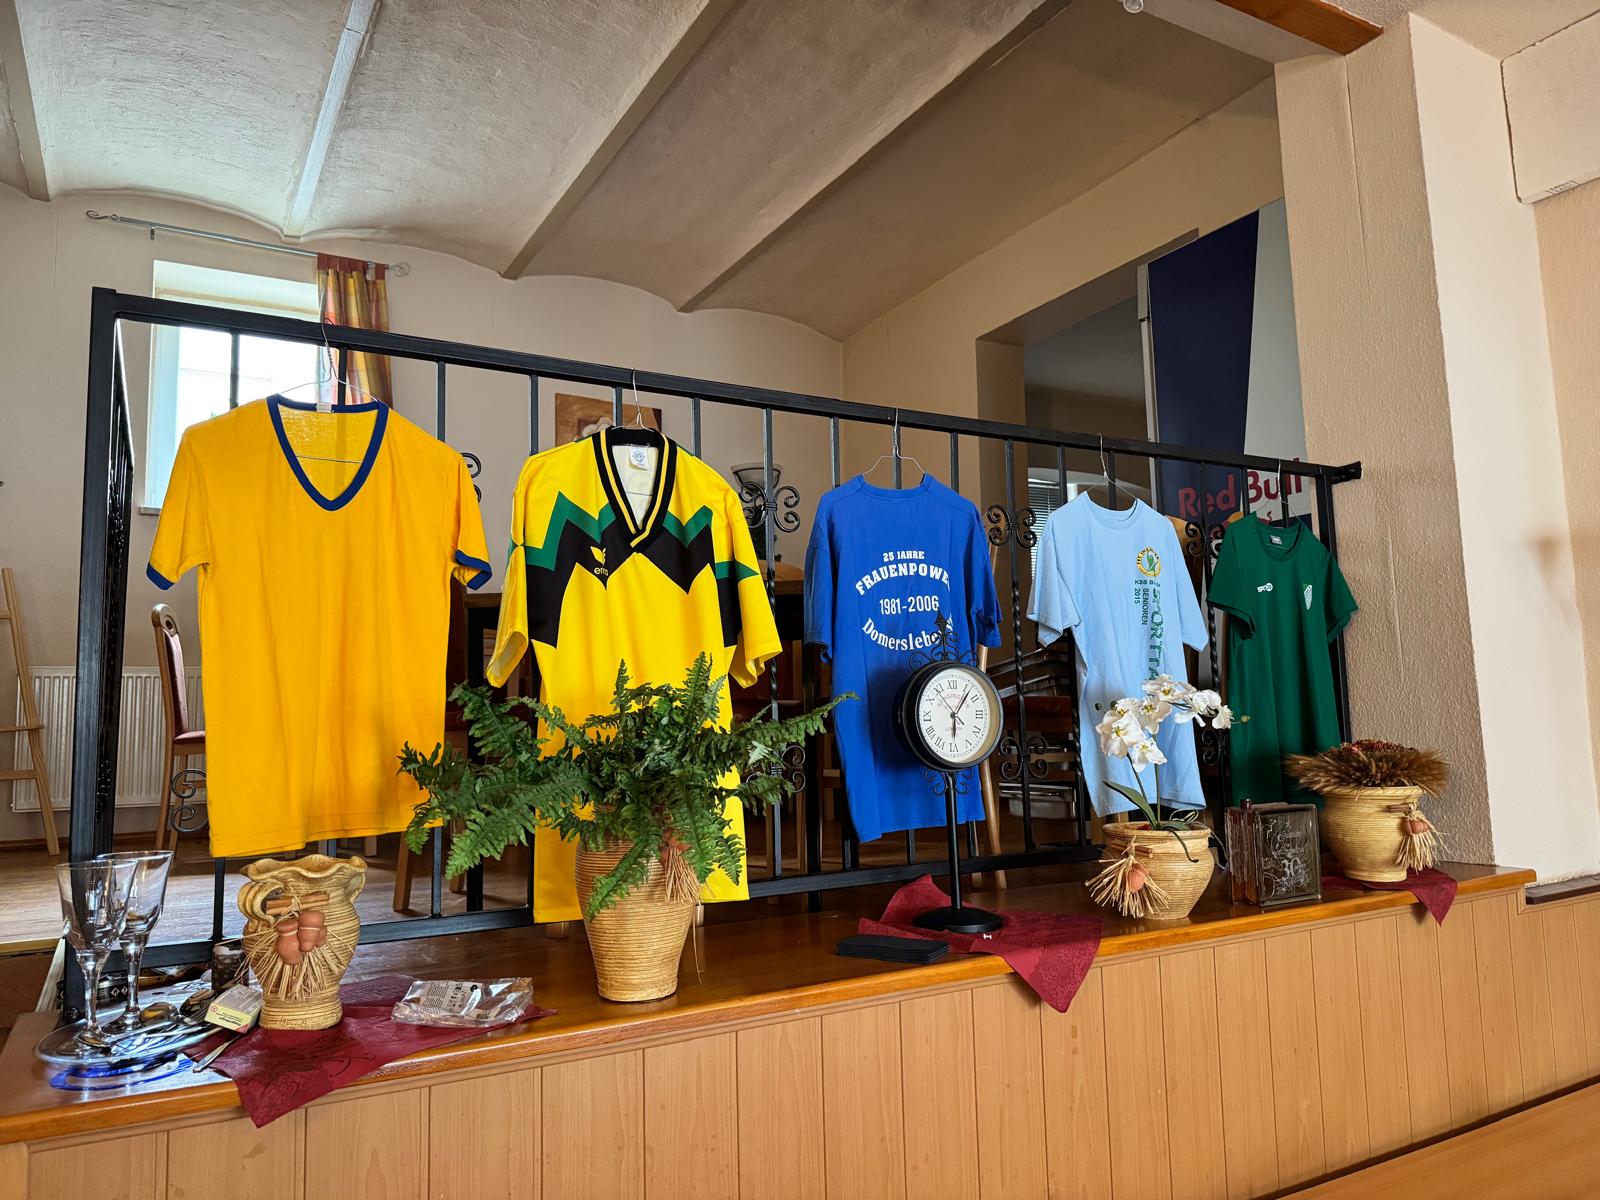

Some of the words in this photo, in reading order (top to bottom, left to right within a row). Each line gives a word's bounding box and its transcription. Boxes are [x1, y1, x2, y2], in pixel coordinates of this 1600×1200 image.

[1178, 473, 1236, 519] Red
[1248, 457, 1303, 504] Bull
[883, 552, 895, 562] 25
[897, 550, 925, 560] JAHRE
[855, 562, 951, 596] FRAUENPOWE
[879, 595, 940, 615] 1981-2006
[1141, 587, 1150, 625] SENIOREN
[933, 683, 944, 694] XI
[947, 680, 958, 690] XII
[970, 694, 979, 703] II
[923, 710, 932, 722] IX
[975, 709, 984, 719] III
[925, 725, 936, 741] VIII
[972, 725, 981, 738] IV
[934, 736, 945, 750] VII
[949, 742, 959, 753] VI
[965, 738, 973, 749] V
